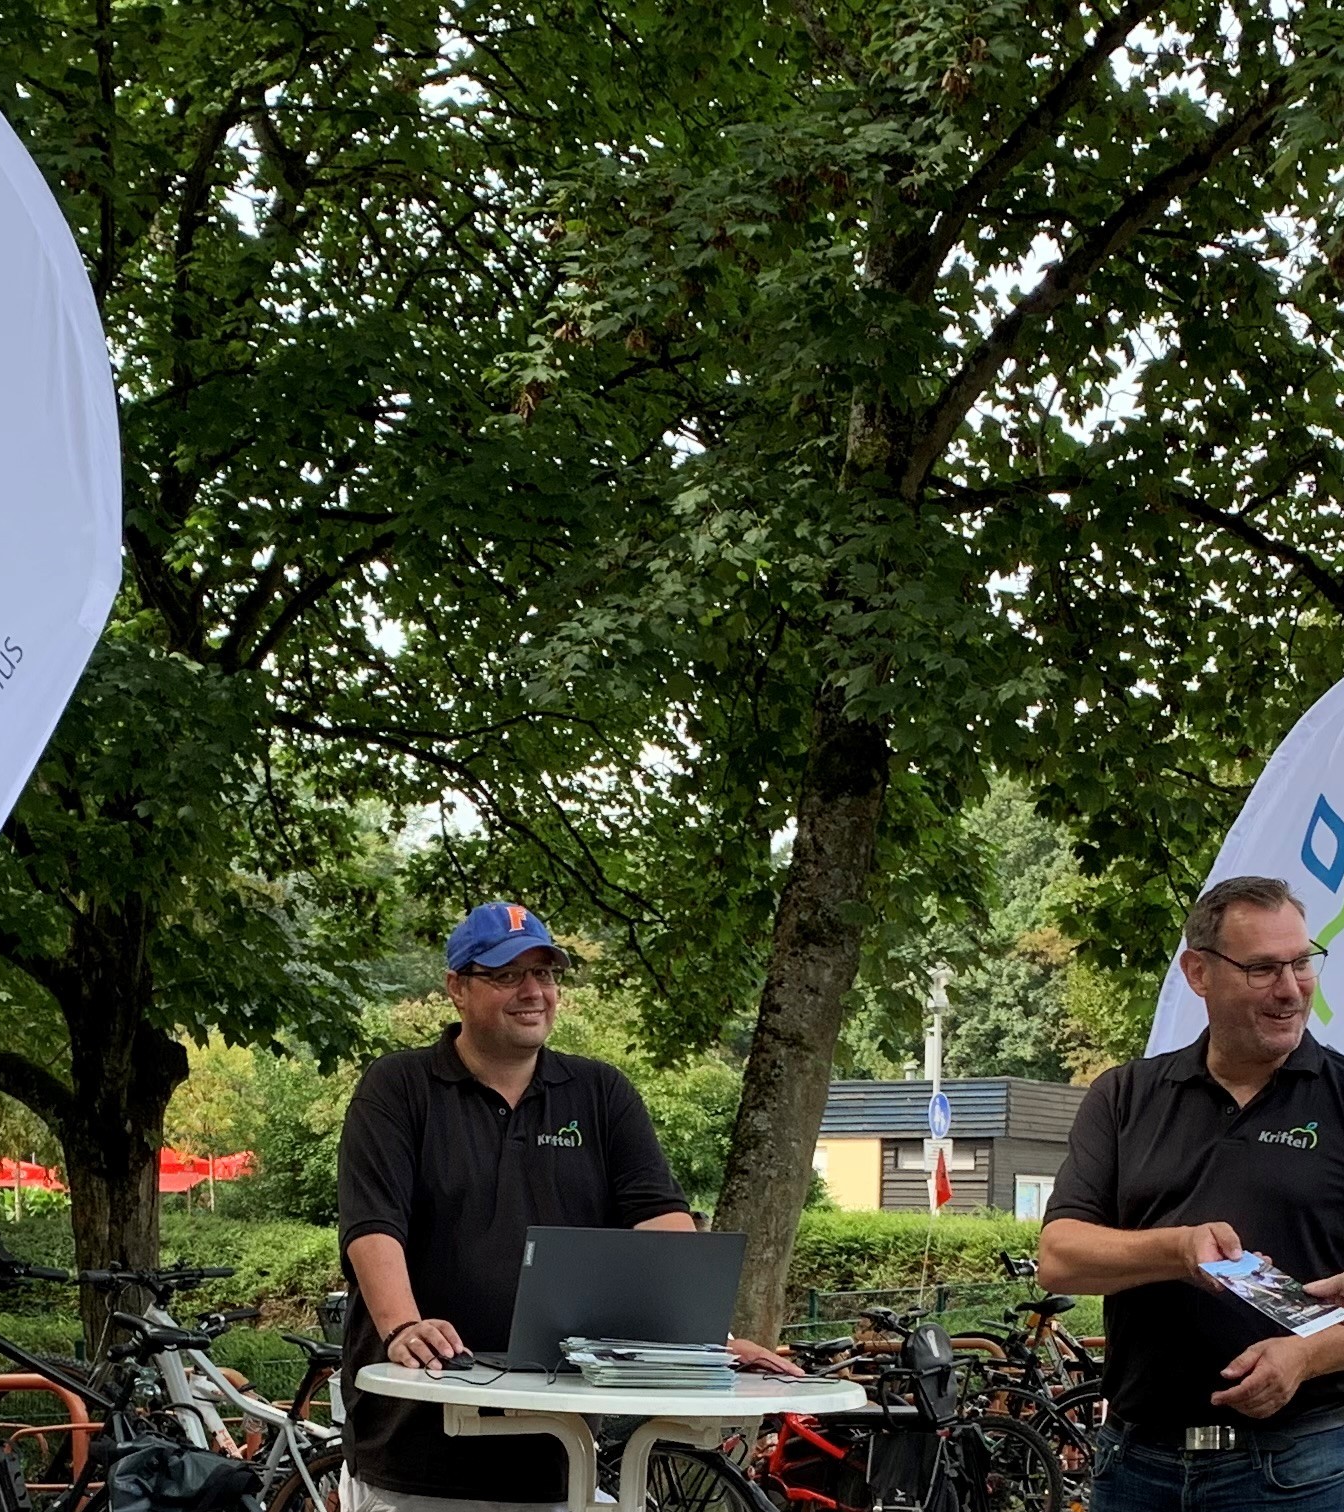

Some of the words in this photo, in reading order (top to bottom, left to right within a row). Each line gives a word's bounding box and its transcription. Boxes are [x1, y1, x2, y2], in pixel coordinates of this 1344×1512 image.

[506, 905, 527, 933] F
[537, 1133, 575, 1147] Krftel
[1258, 1130, 1308, 1149] Kriftel
